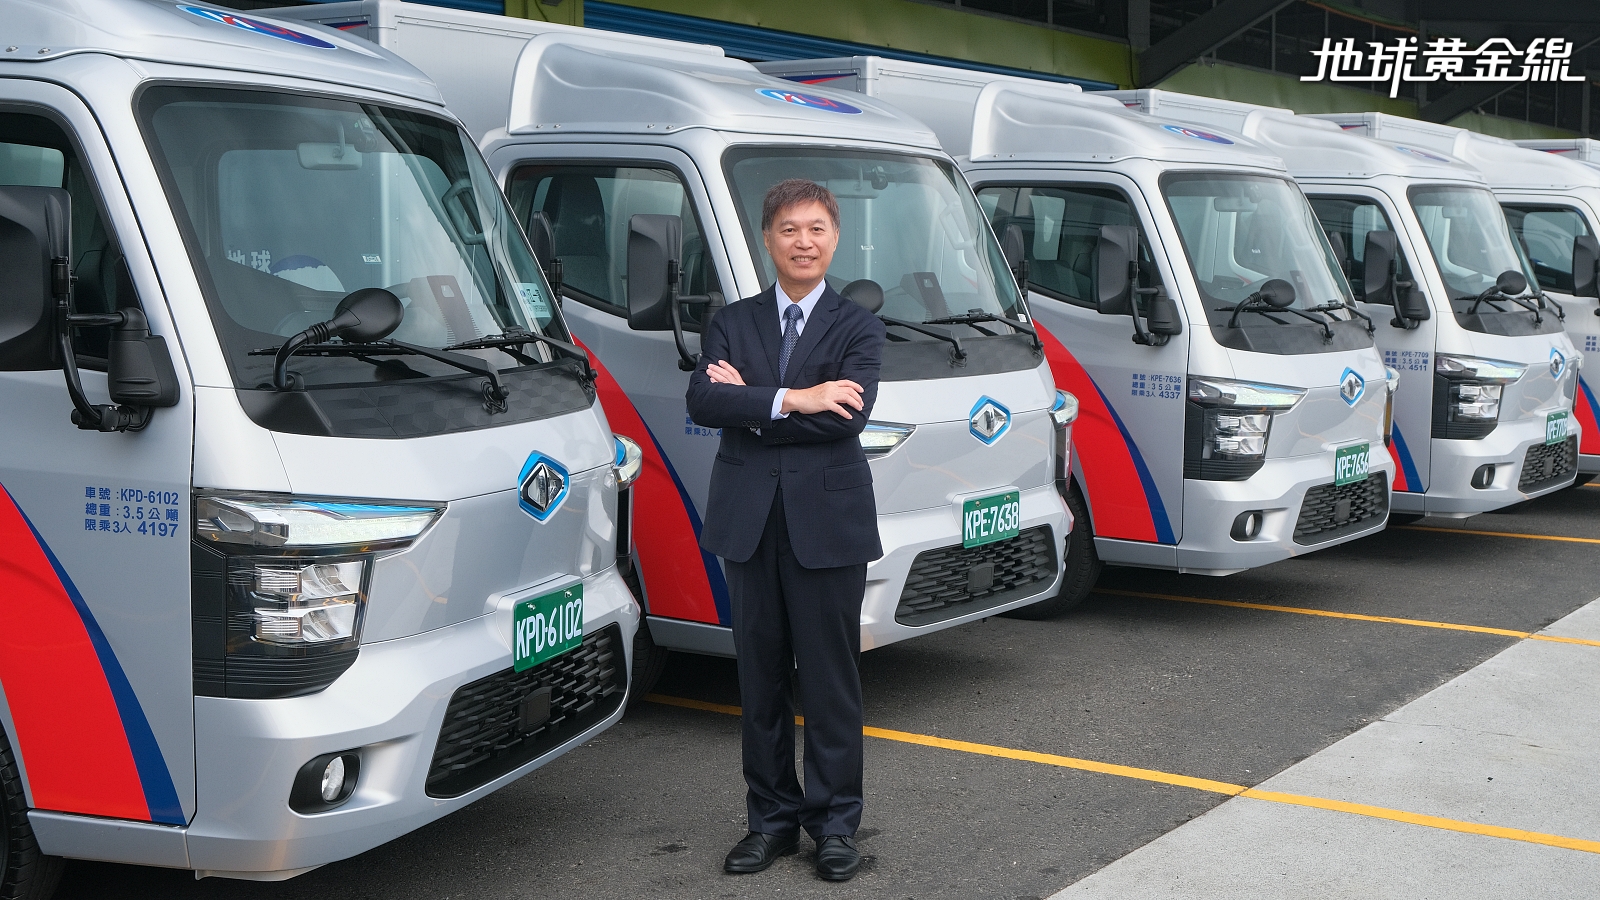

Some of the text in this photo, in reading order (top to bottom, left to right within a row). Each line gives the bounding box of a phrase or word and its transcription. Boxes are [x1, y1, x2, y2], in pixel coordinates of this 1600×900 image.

[1158, 390, 1181, 400] 4337
[1336, 451, 1369, 481] KPE-7636
[137, 520, 179, 538] 4197
[965, 501, 1019, 541] KPE-7638
[516, 598, 582, 661] KPD-6102
